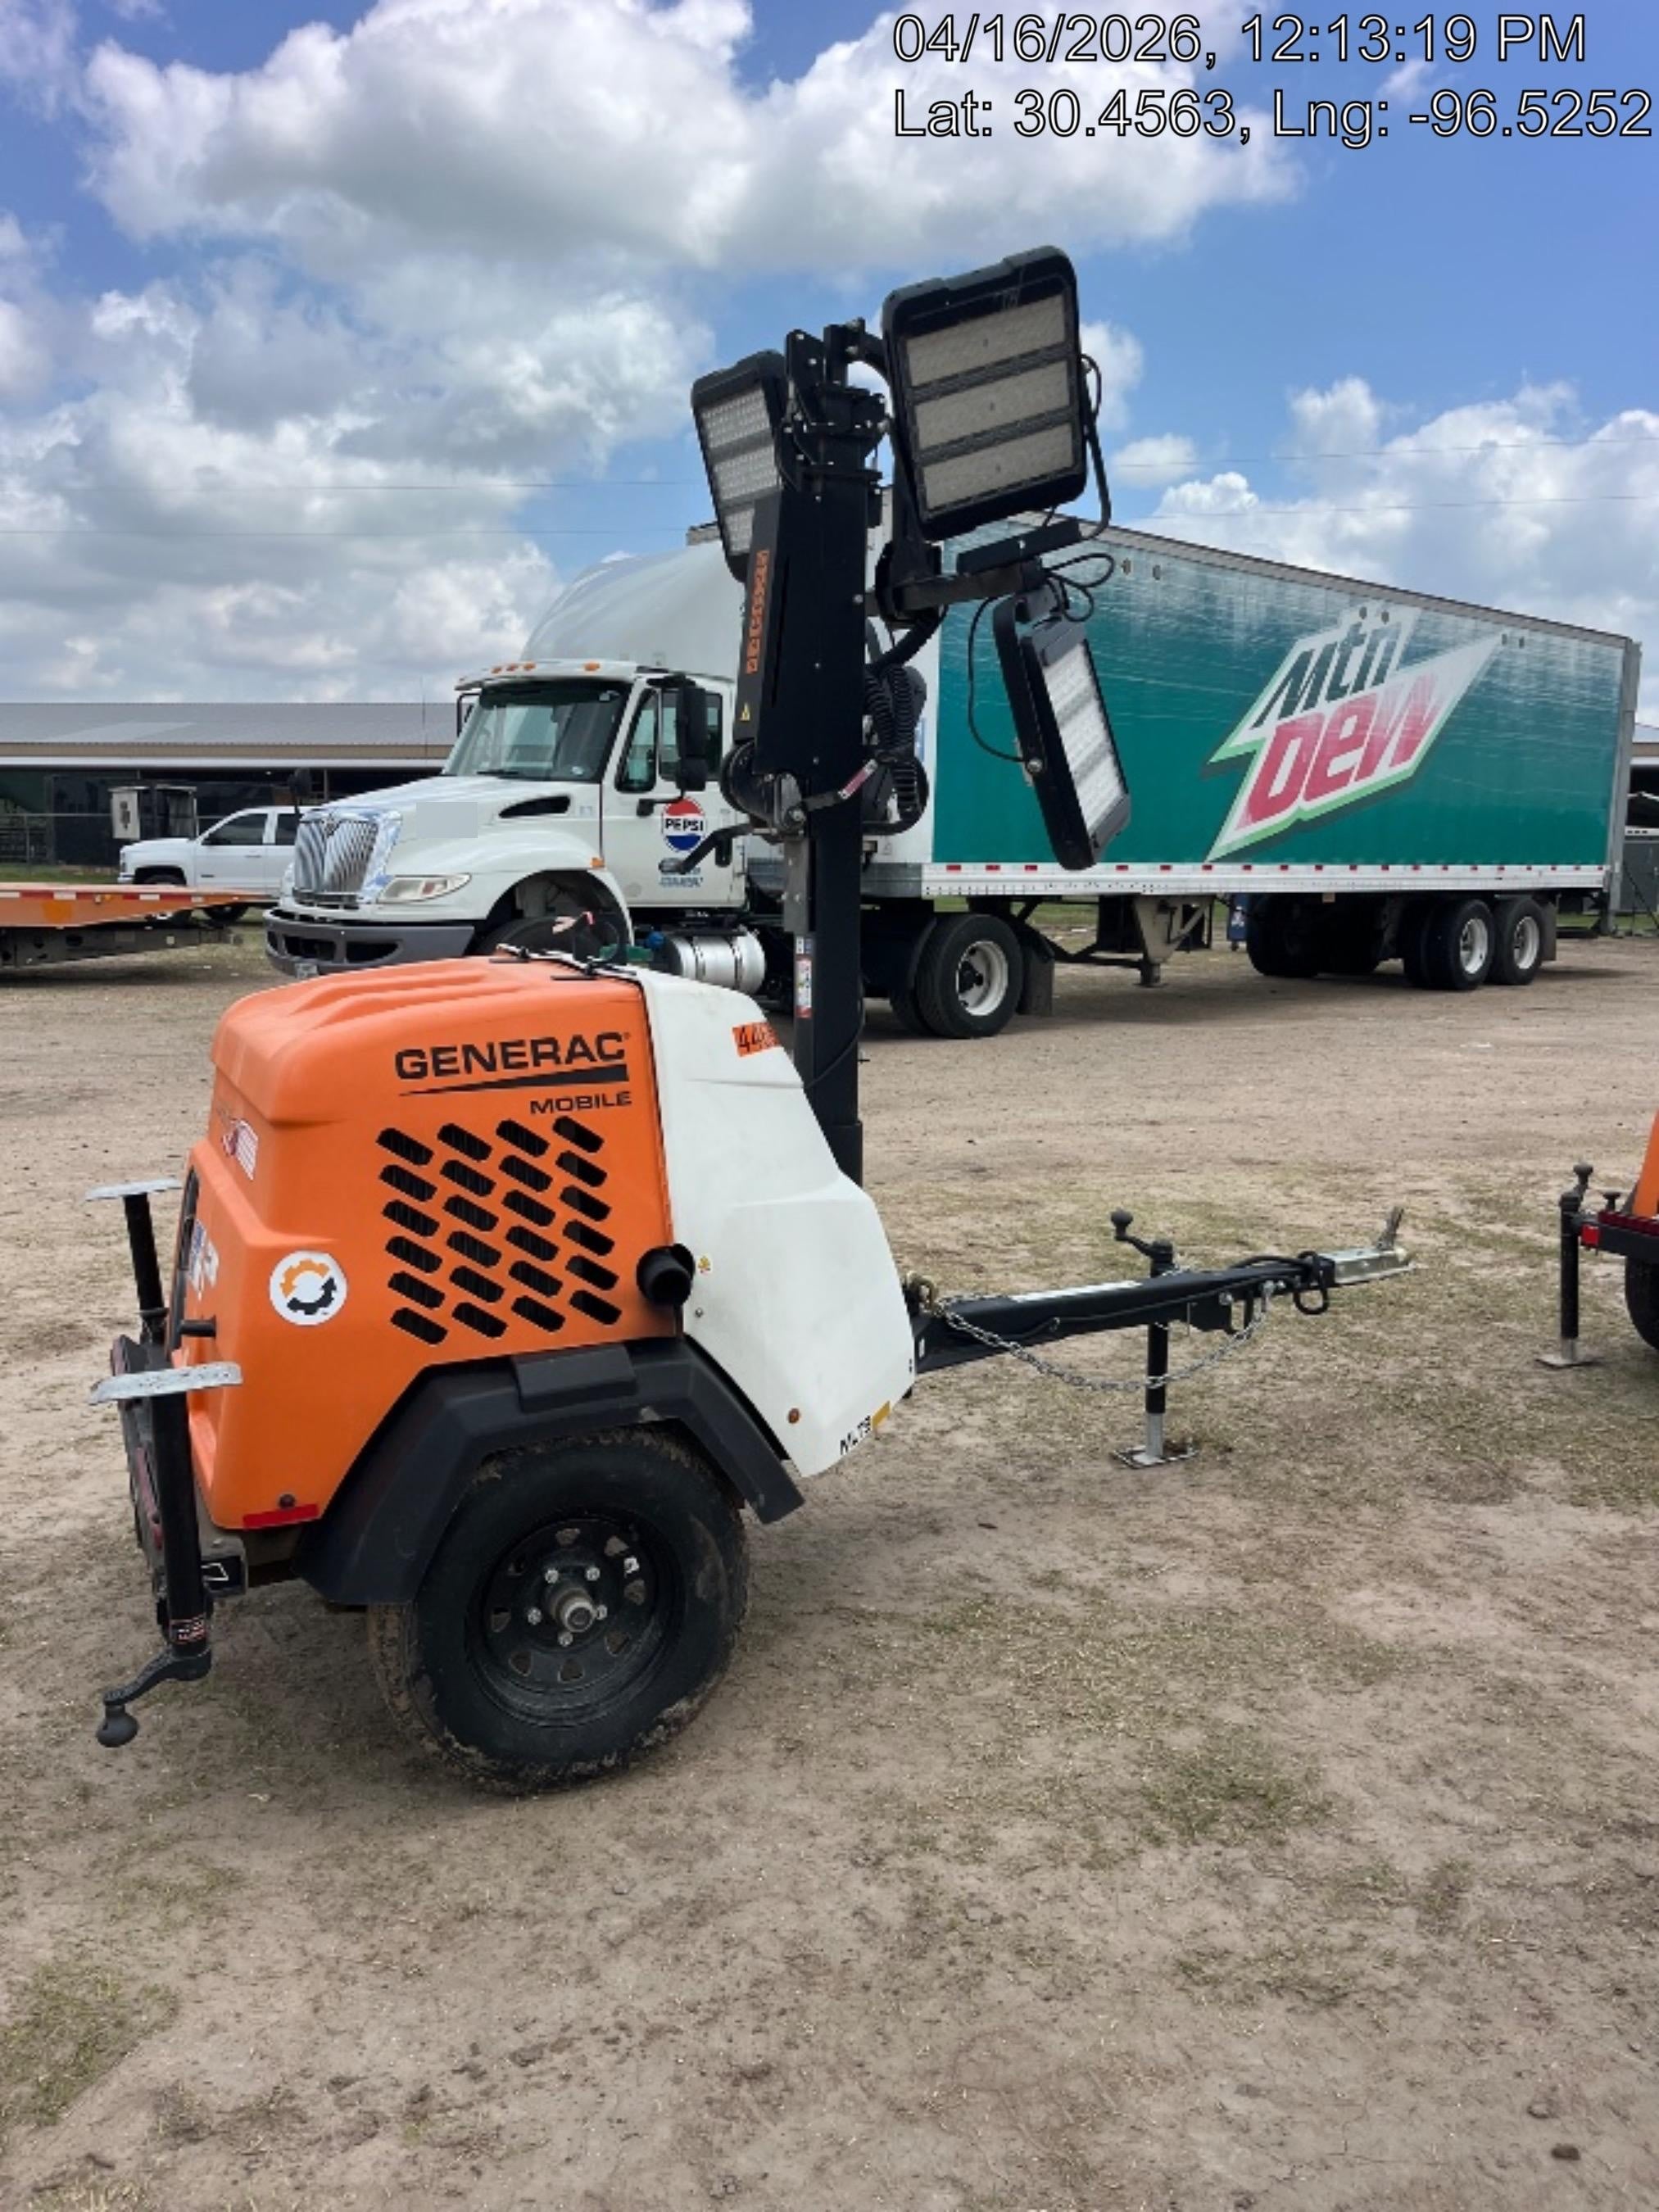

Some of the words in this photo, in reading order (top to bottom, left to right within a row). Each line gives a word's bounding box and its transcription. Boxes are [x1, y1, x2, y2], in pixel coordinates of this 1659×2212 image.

[664, 818, 704, 832] PEPSI
[395, 1031, 625, 1080] GENERAC
[529, 1090, 632, 1115] MOBILE
